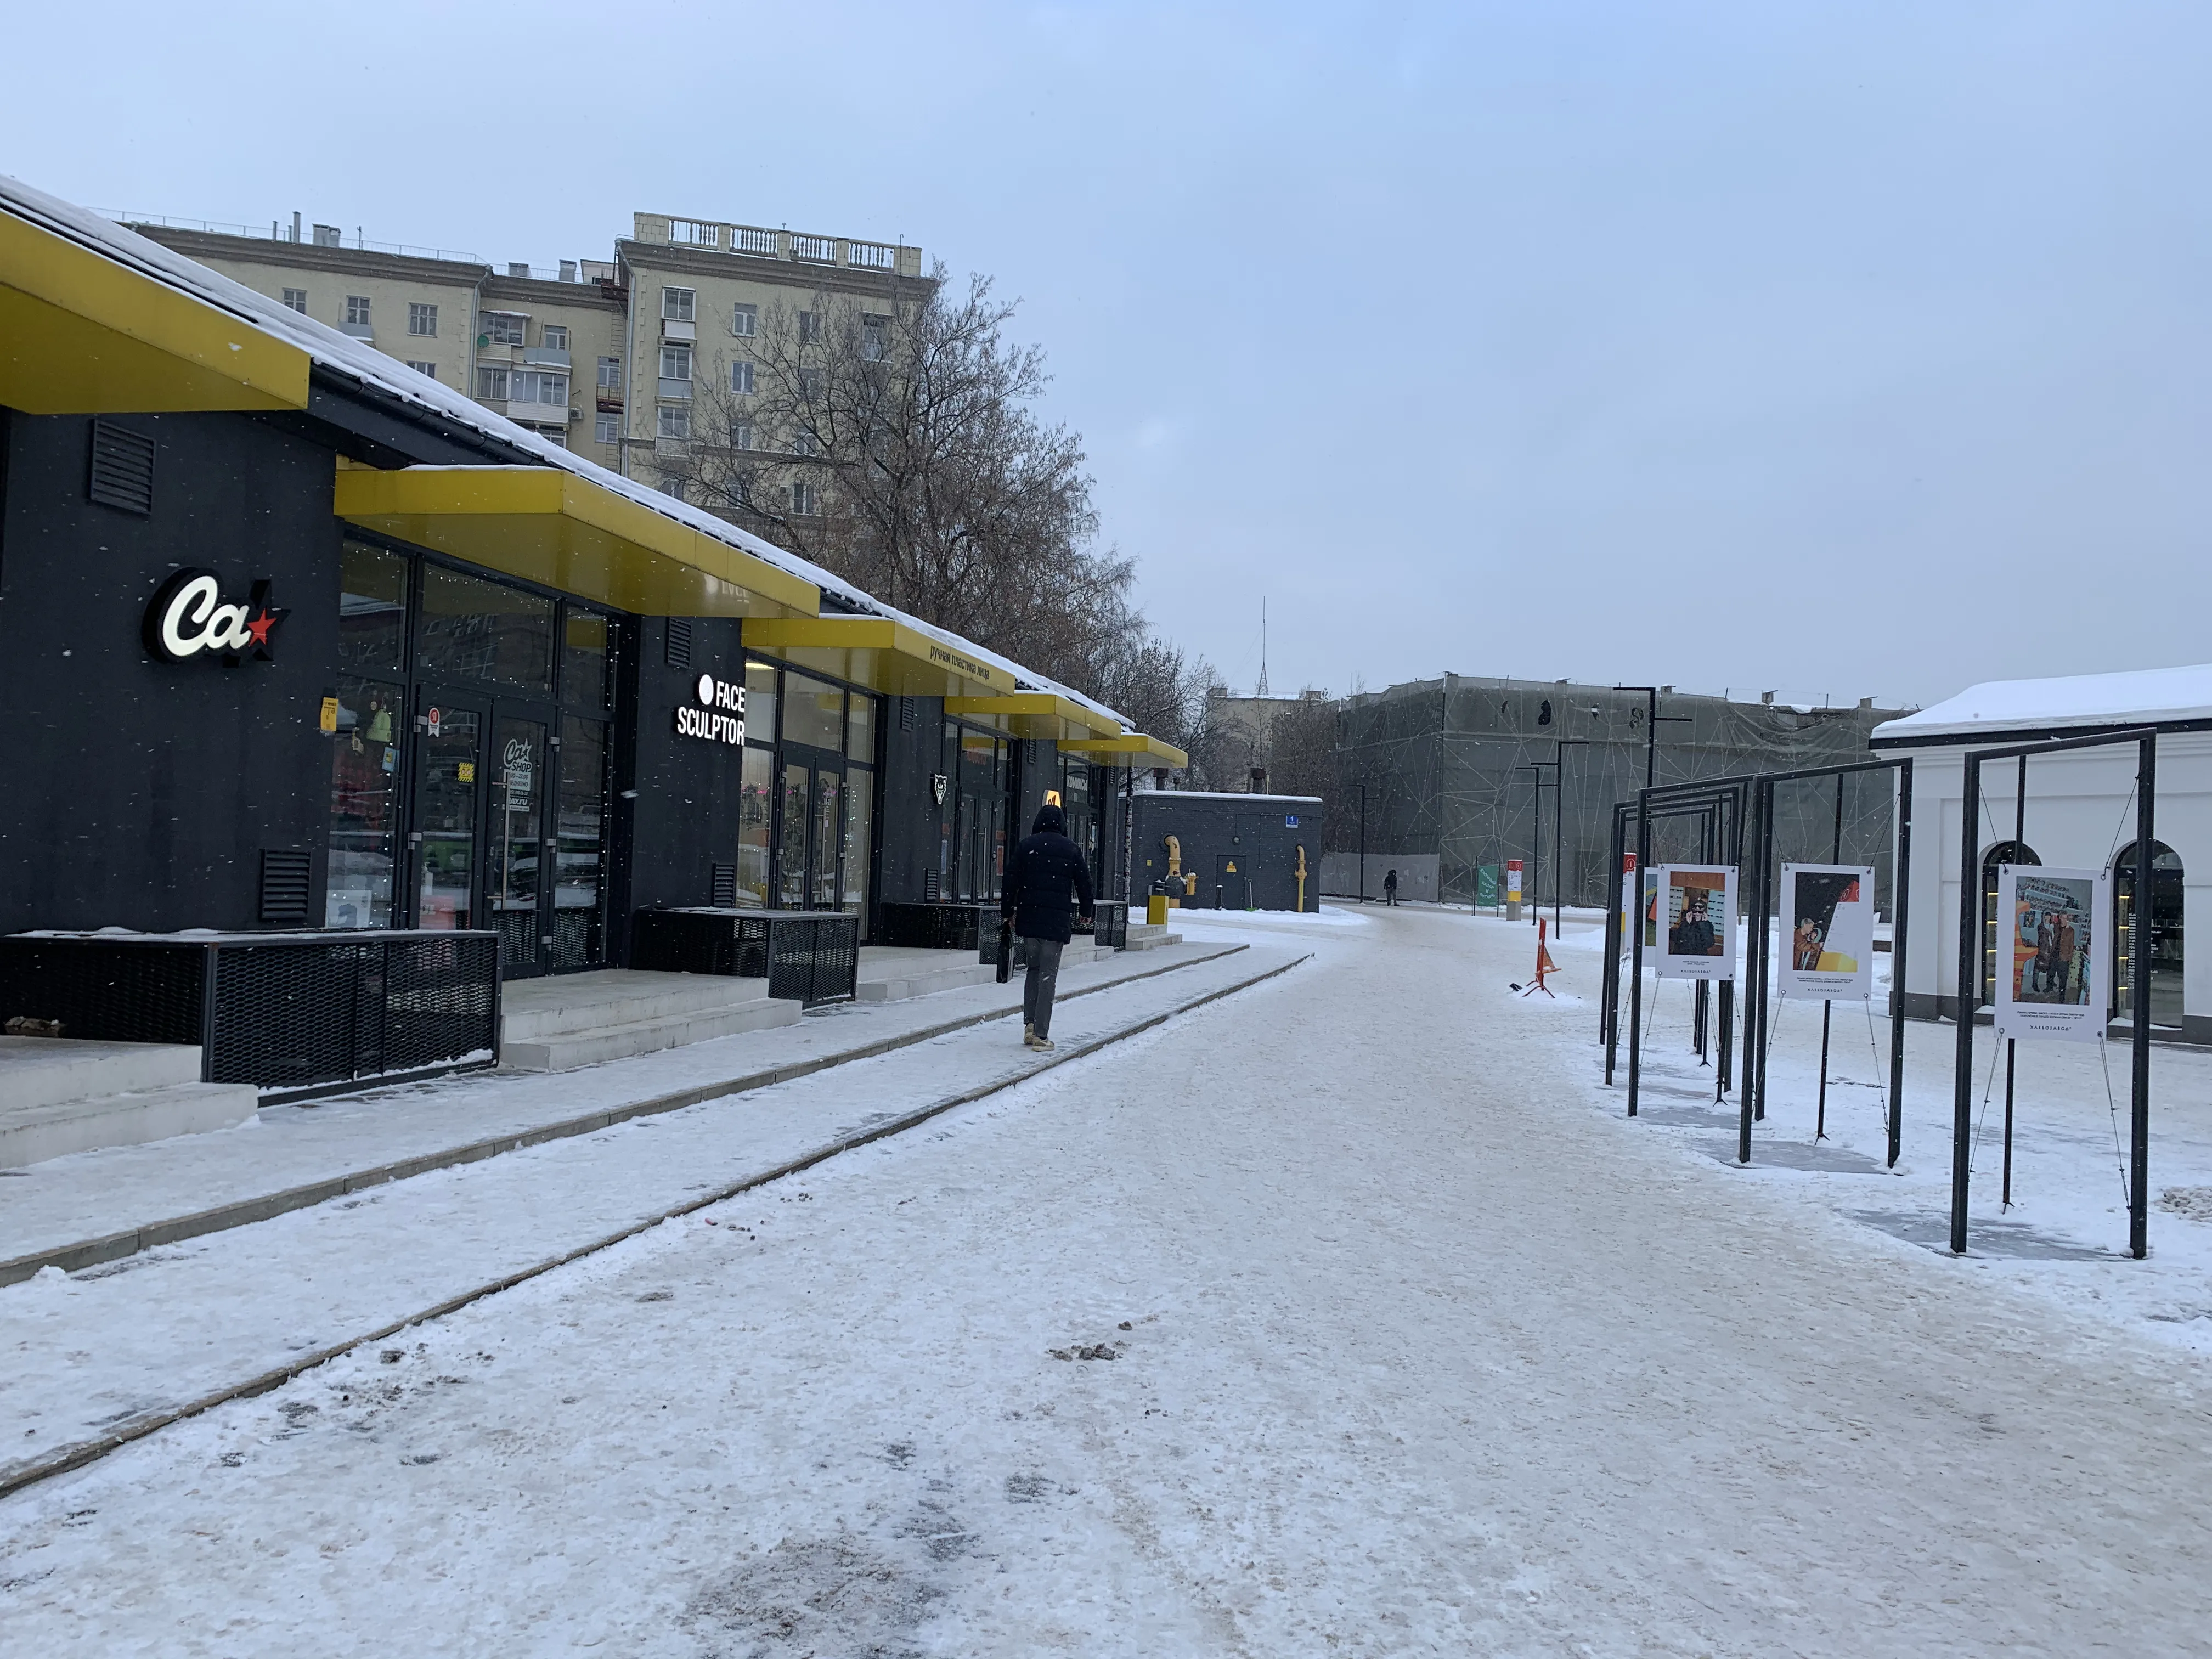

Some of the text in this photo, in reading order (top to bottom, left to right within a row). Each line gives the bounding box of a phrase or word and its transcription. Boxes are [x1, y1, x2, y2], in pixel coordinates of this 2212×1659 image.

[930, 645, 990, 681] ручная пластика лица
[716, 680, 746, 713] FACE
[678, 706, 744, 746] SCULPTOR
[511, 761, 532, 772] SHOP
[1066, 775, 1088, 791] КОМИКСЫ
[1481, 881, 1495, 889] БАЗАР
